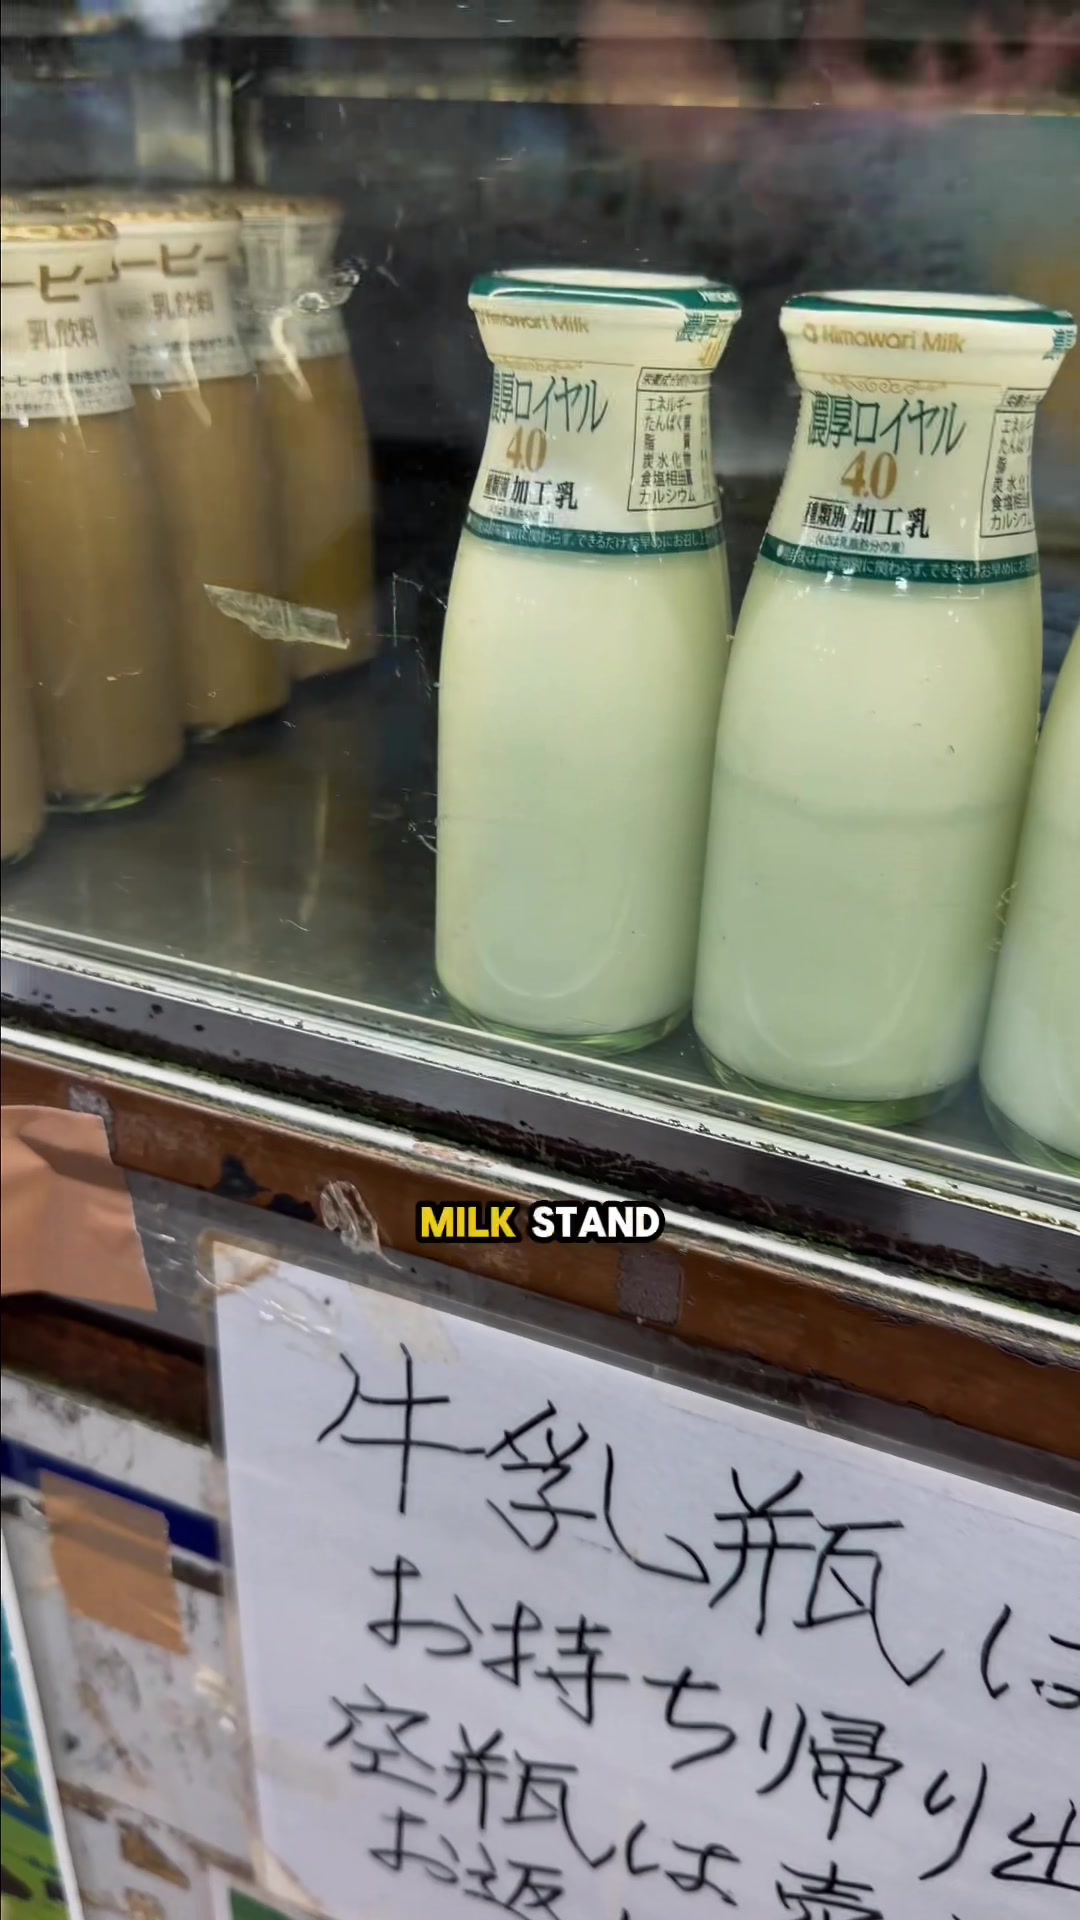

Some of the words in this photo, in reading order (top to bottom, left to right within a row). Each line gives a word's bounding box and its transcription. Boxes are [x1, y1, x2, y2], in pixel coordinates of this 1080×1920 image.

[551, 313, 589, 333] Milk
[822, 324, 917, 350] Himawari
[921, 330, 966, 353] Milk
[841, 450, 897, 499] 4.0
[512, 475, 578, 511] 加工乳
[850, 503, 929, 538] 加工乳
